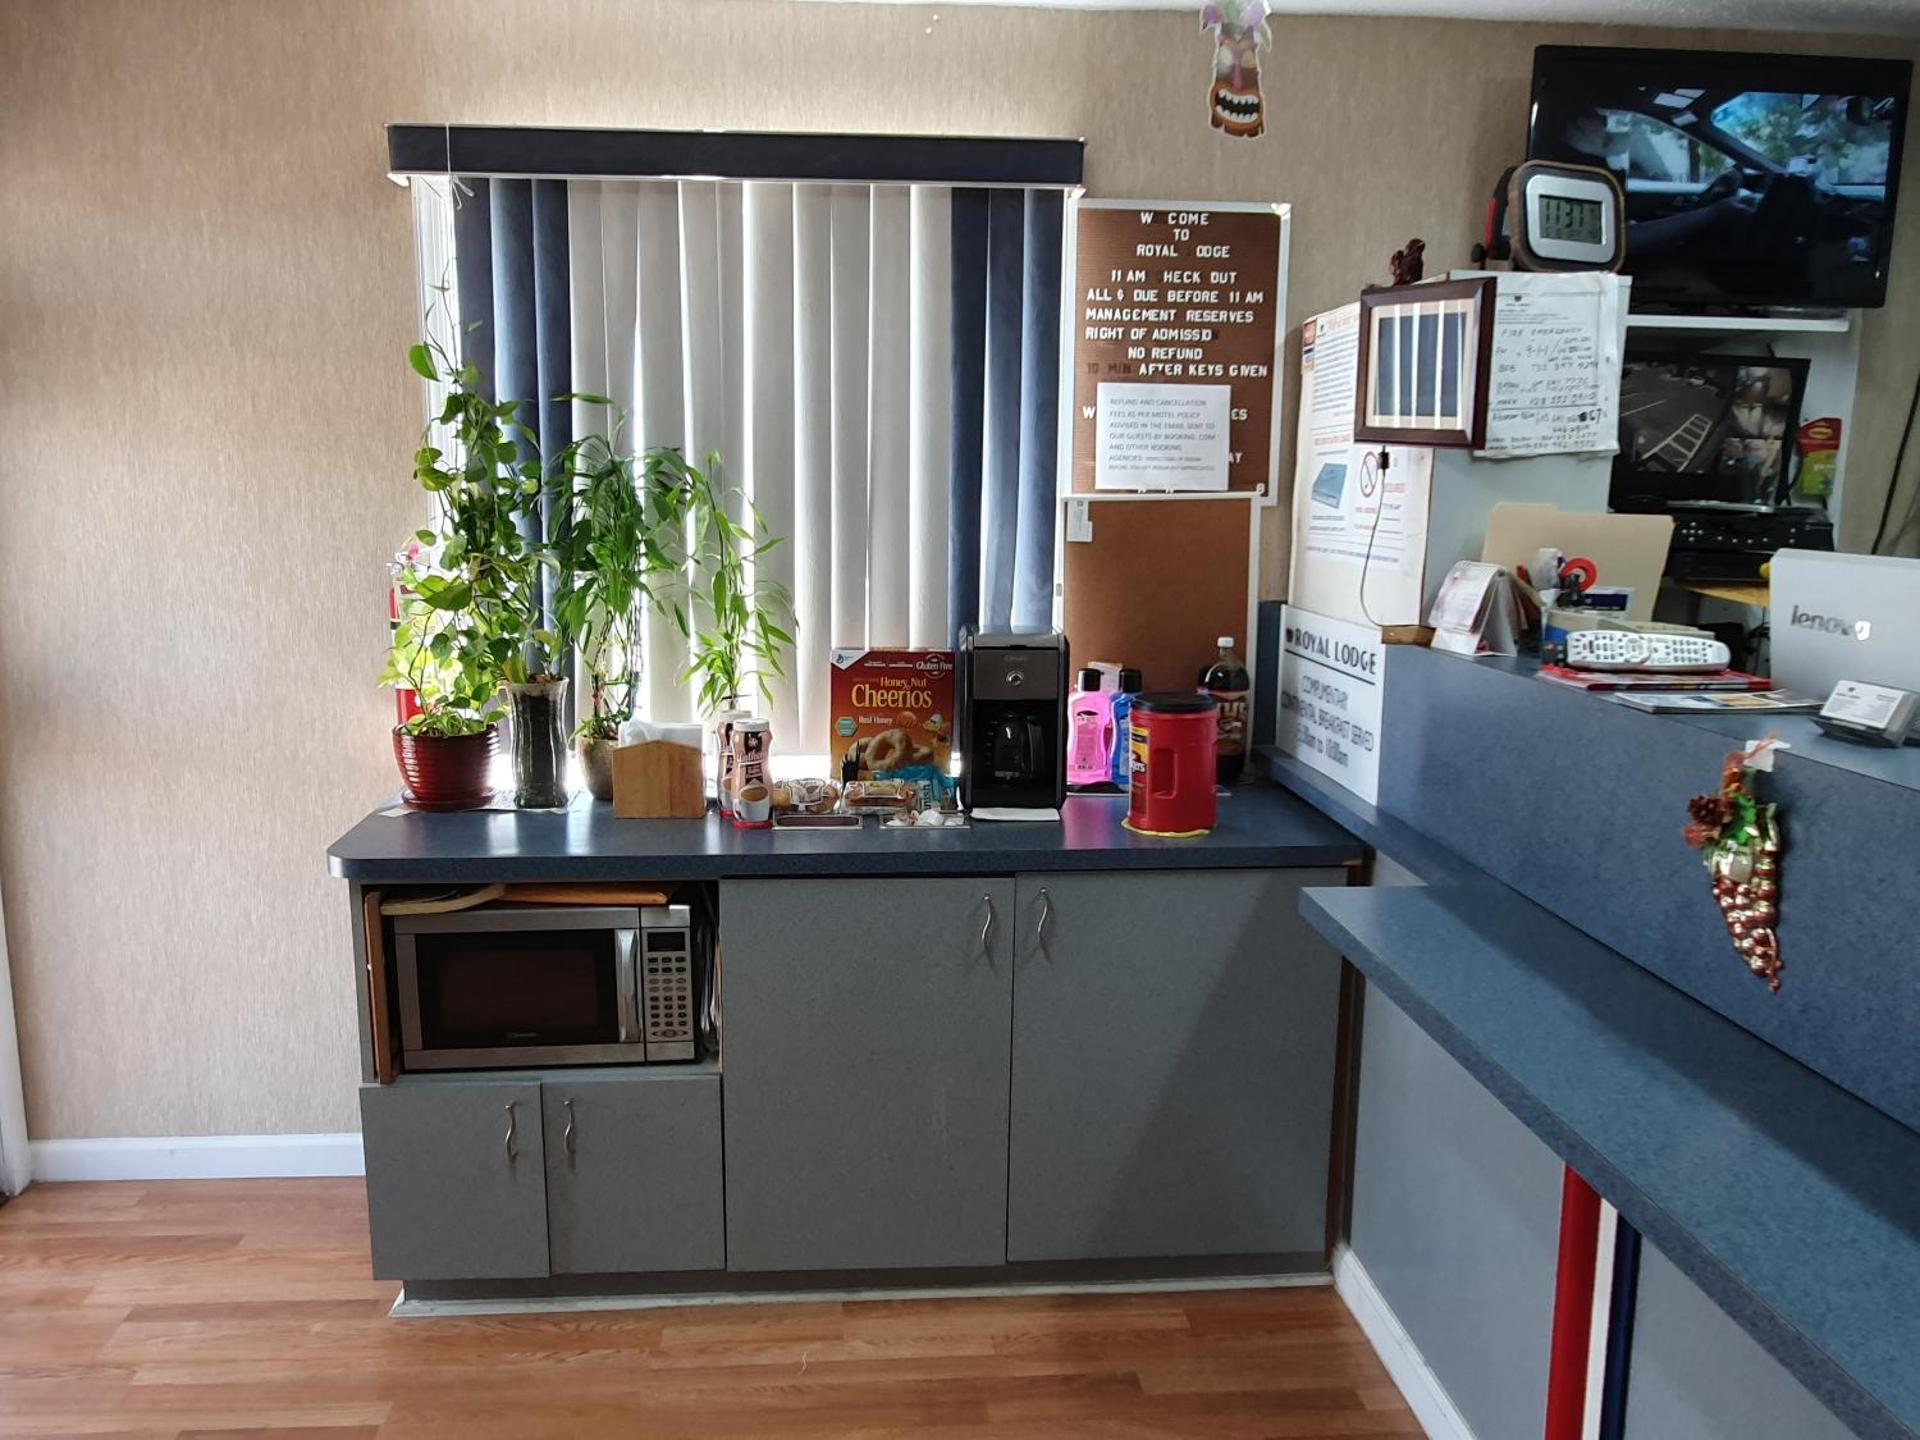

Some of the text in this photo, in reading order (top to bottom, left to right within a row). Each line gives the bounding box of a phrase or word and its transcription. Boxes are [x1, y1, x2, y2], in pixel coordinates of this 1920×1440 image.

[1173, 228, 1190, 241] TO
[1136, 245, 1178, 257] ROYAL
[1127, 270, 1146, 283] AM
[1163, 271, 1200, 284] HECK
[1210, 272, 1237, 284] OUT
[1087, 288, 1112, 301] ALL
[1133, 289, 1159, 302] DUE
[1167, 290, 1219, 303] BEFORE
[1244, 291, 1264, 304] AM
[1085, 308, 1254, 323] MANAGEMENT RESERVES
[1085, 327, 1125, 340] RIGHT
[1130, 327, 1148, 340] OF
[1128, 347, 1203, 360] NO REFUND
[1138, 363, 1183, 376] AFTER
[1188, 364, 1224, 377] KEYS
[1228, 364, 1268, 377] GIVEN
[1294, 628, 1377, 675] ROYAL LODGE
[880, 677, 927, 690] Honey Nut
[852, 684, 932, 708] Cheerios
